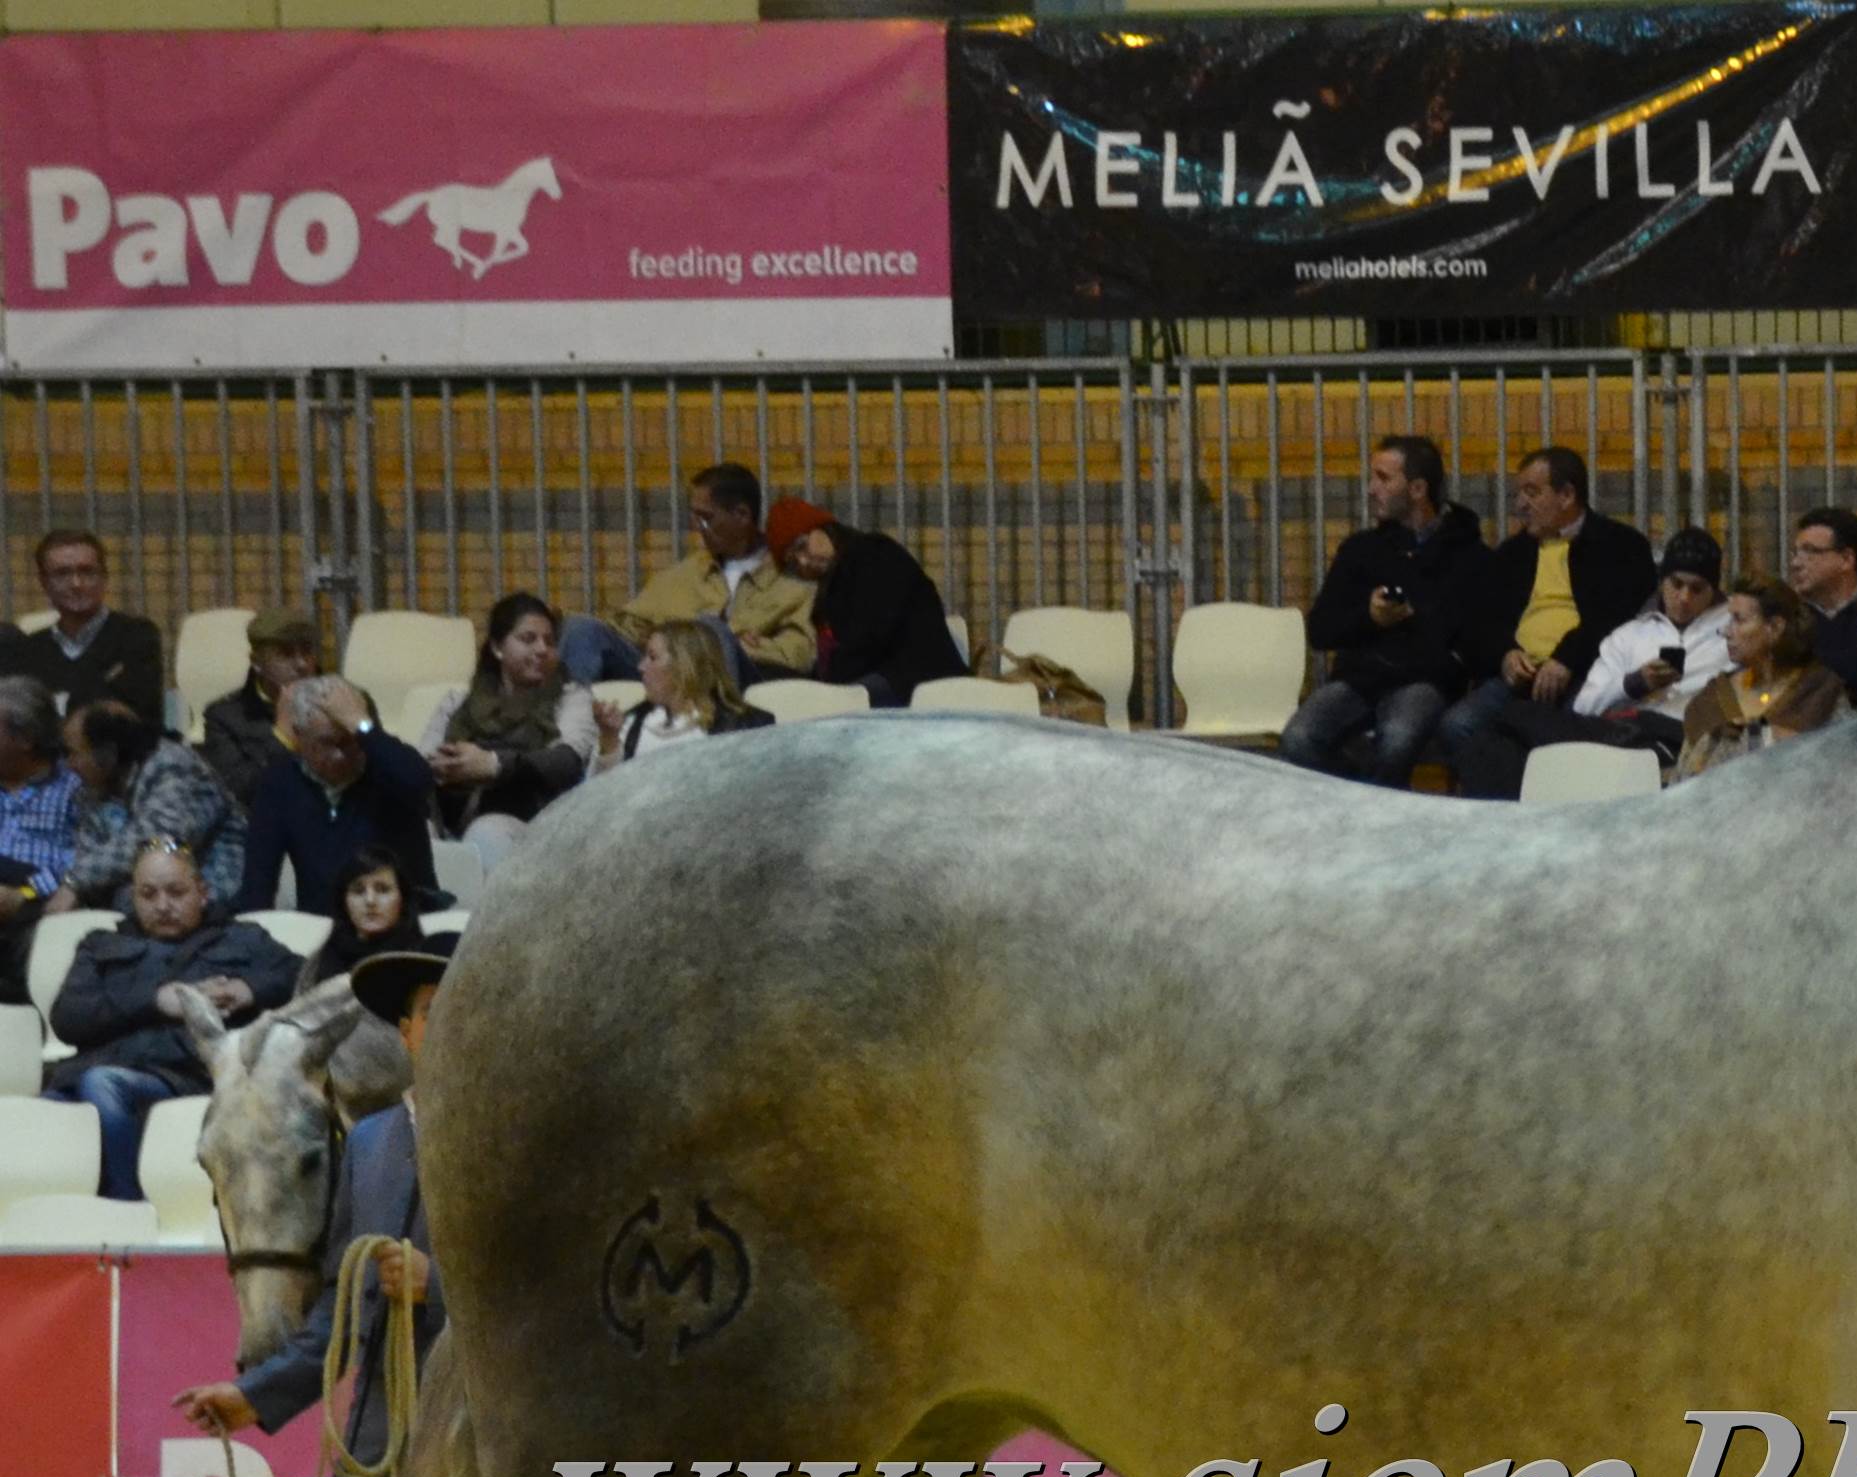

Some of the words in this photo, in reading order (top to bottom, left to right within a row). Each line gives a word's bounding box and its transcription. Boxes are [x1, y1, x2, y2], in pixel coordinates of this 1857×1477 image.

[1379, 117, 1822, 203] SEVILLA
[26, 165, 361, 291] Pavo
[628, 245, 743, 285] feeding
[751, 245, 918, 277] excellence
[1294, 254, 1489, 280] meliahotels.com
